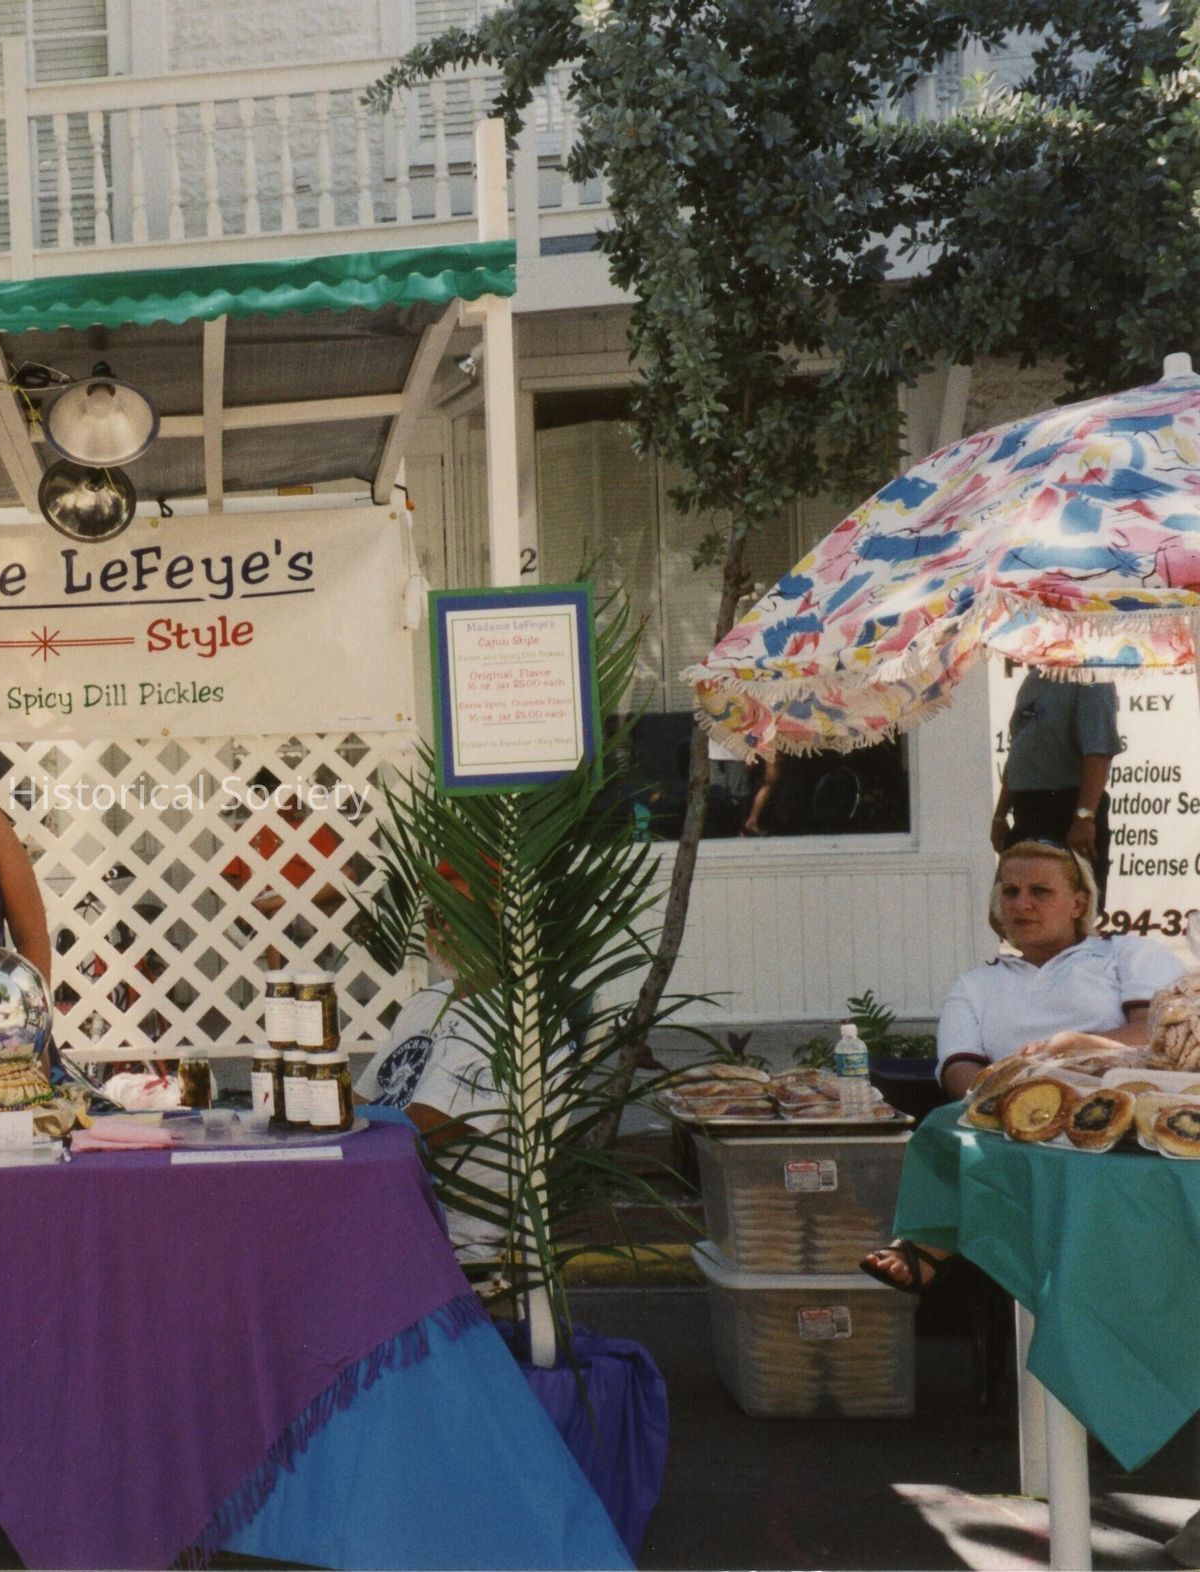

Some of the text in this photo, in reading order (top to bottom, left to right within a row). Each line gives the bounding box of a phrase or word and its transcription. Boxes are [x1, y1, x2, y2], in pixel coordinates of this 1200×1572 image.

[60, 538, 314, 600] LeFeye's
[520, 548, 537, 576] 2
[147, 615, 254, 658] Style
[477, 634, 540, 649] Cajun Style
[469, 668, 552, 682] Original Flavor
[7, 687, 73, 715] Spicy
[83, 683, 127, 707] Dill
[139, 680, 224, 705] Pickles
[1128, 694, 1174, 711] KEY
[1108, 759, 1182, 788] pacious
[1109, 792, 1171, 815] utdoor
[1119, 853, 1189, 877] License
